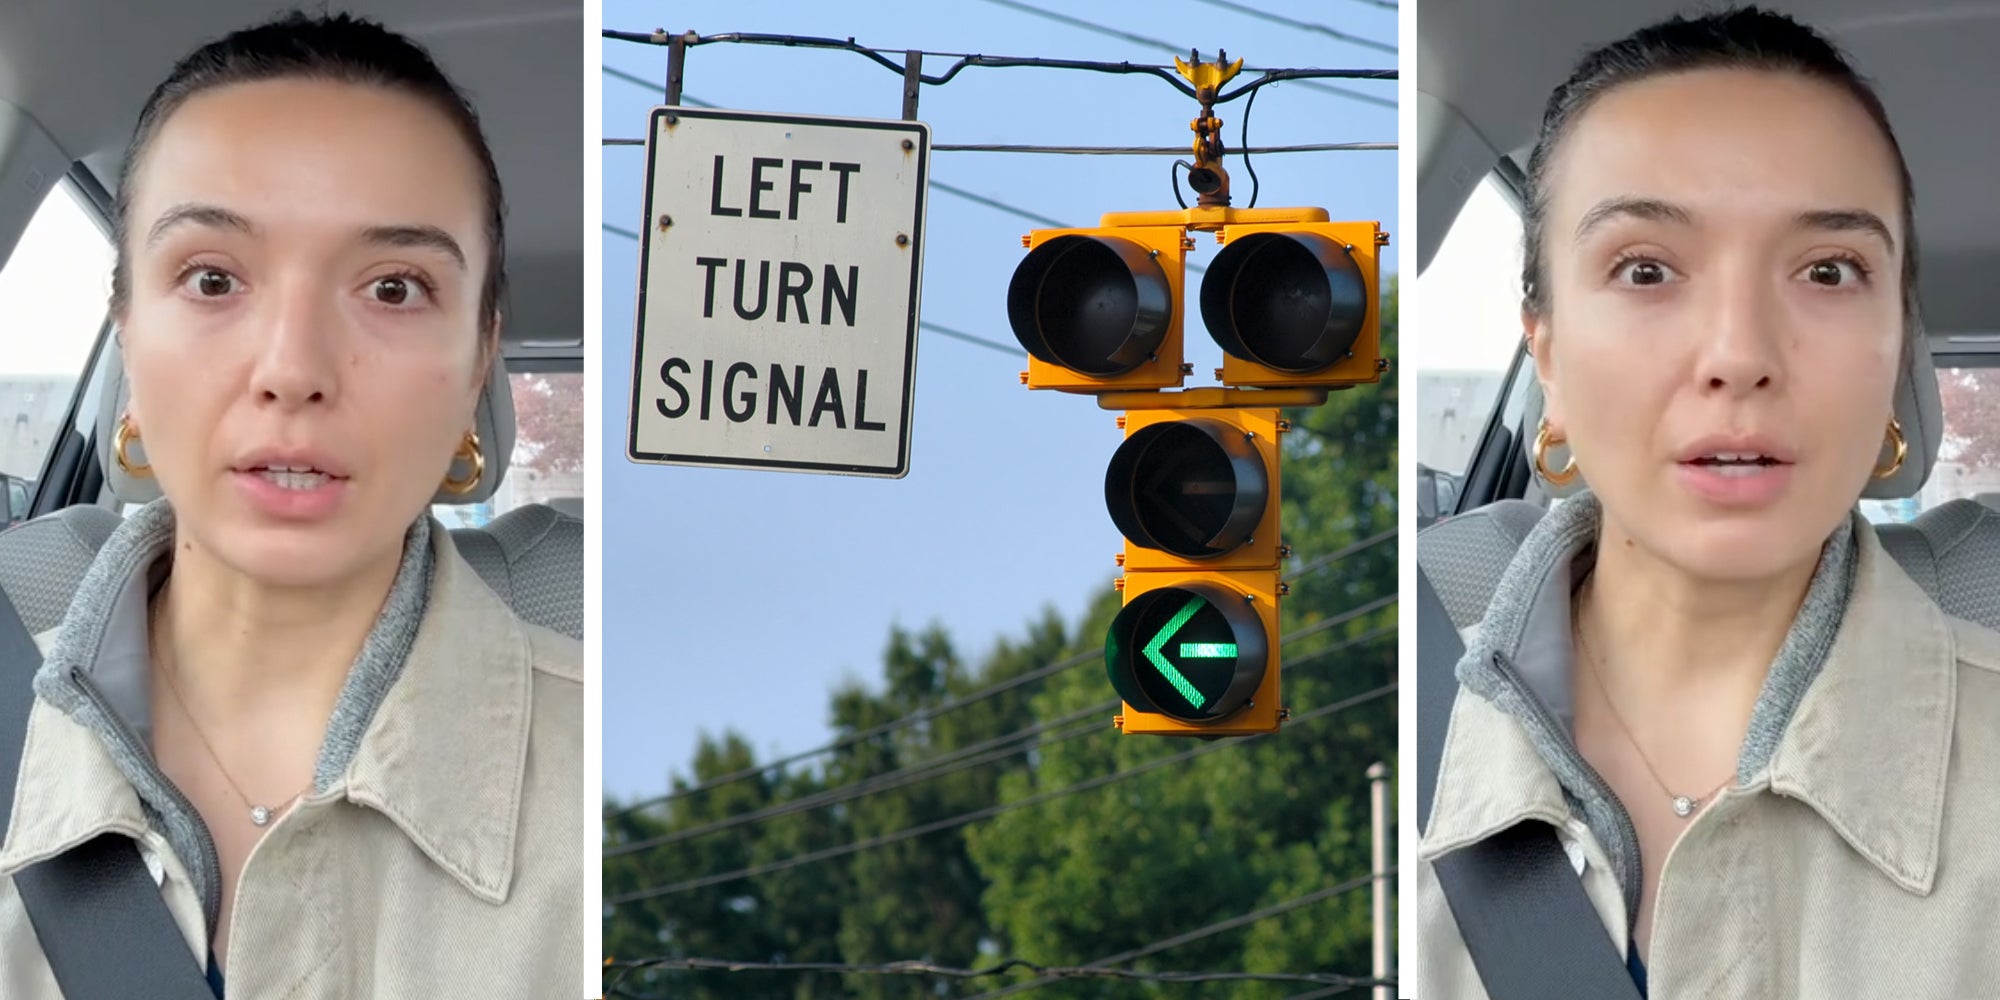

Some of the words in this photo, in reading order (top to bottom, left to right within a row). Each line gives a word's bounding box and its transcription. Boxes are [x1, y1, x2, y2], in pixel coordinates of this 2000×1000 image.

[711, 155, 861, 223] LEFT
[696, 257, 859, 326] TURN
[656, 357, 886, 431] SIGNAL
